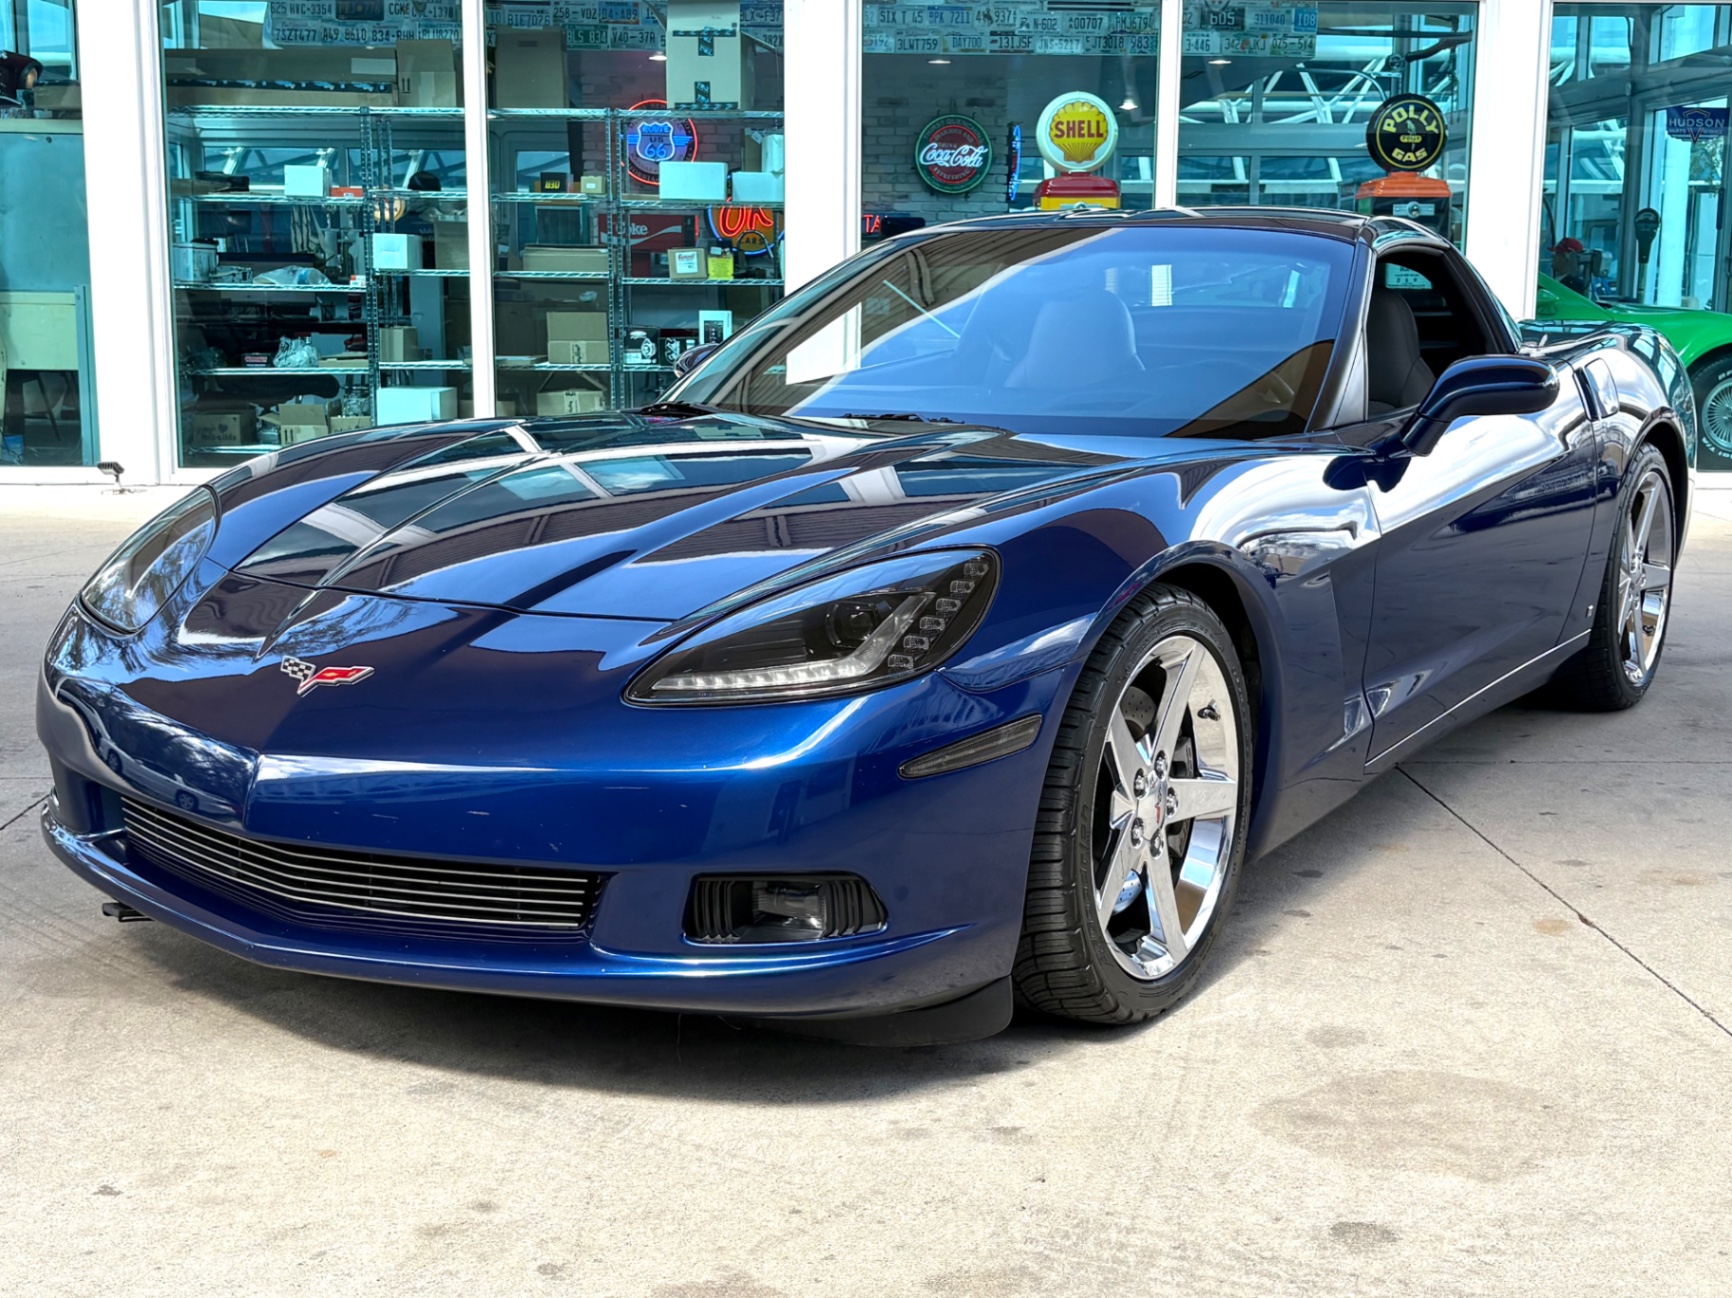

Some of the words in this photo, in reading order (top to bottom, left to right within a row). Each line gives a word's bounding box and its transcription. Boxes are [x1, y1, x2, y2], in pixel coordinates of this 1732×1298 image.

[1382, 104, 1440, 134] POLLY
[1669, 118, 1725, 129] HUDSON
[642, 125, 670, 133] ROUTE
[1054, 119, 1104, 139] SHELL
[644, 142, 667, 159] 66
[919, 142, 989, 168] Coca-Cola
[1391, 147, 1428, 162] GAS
